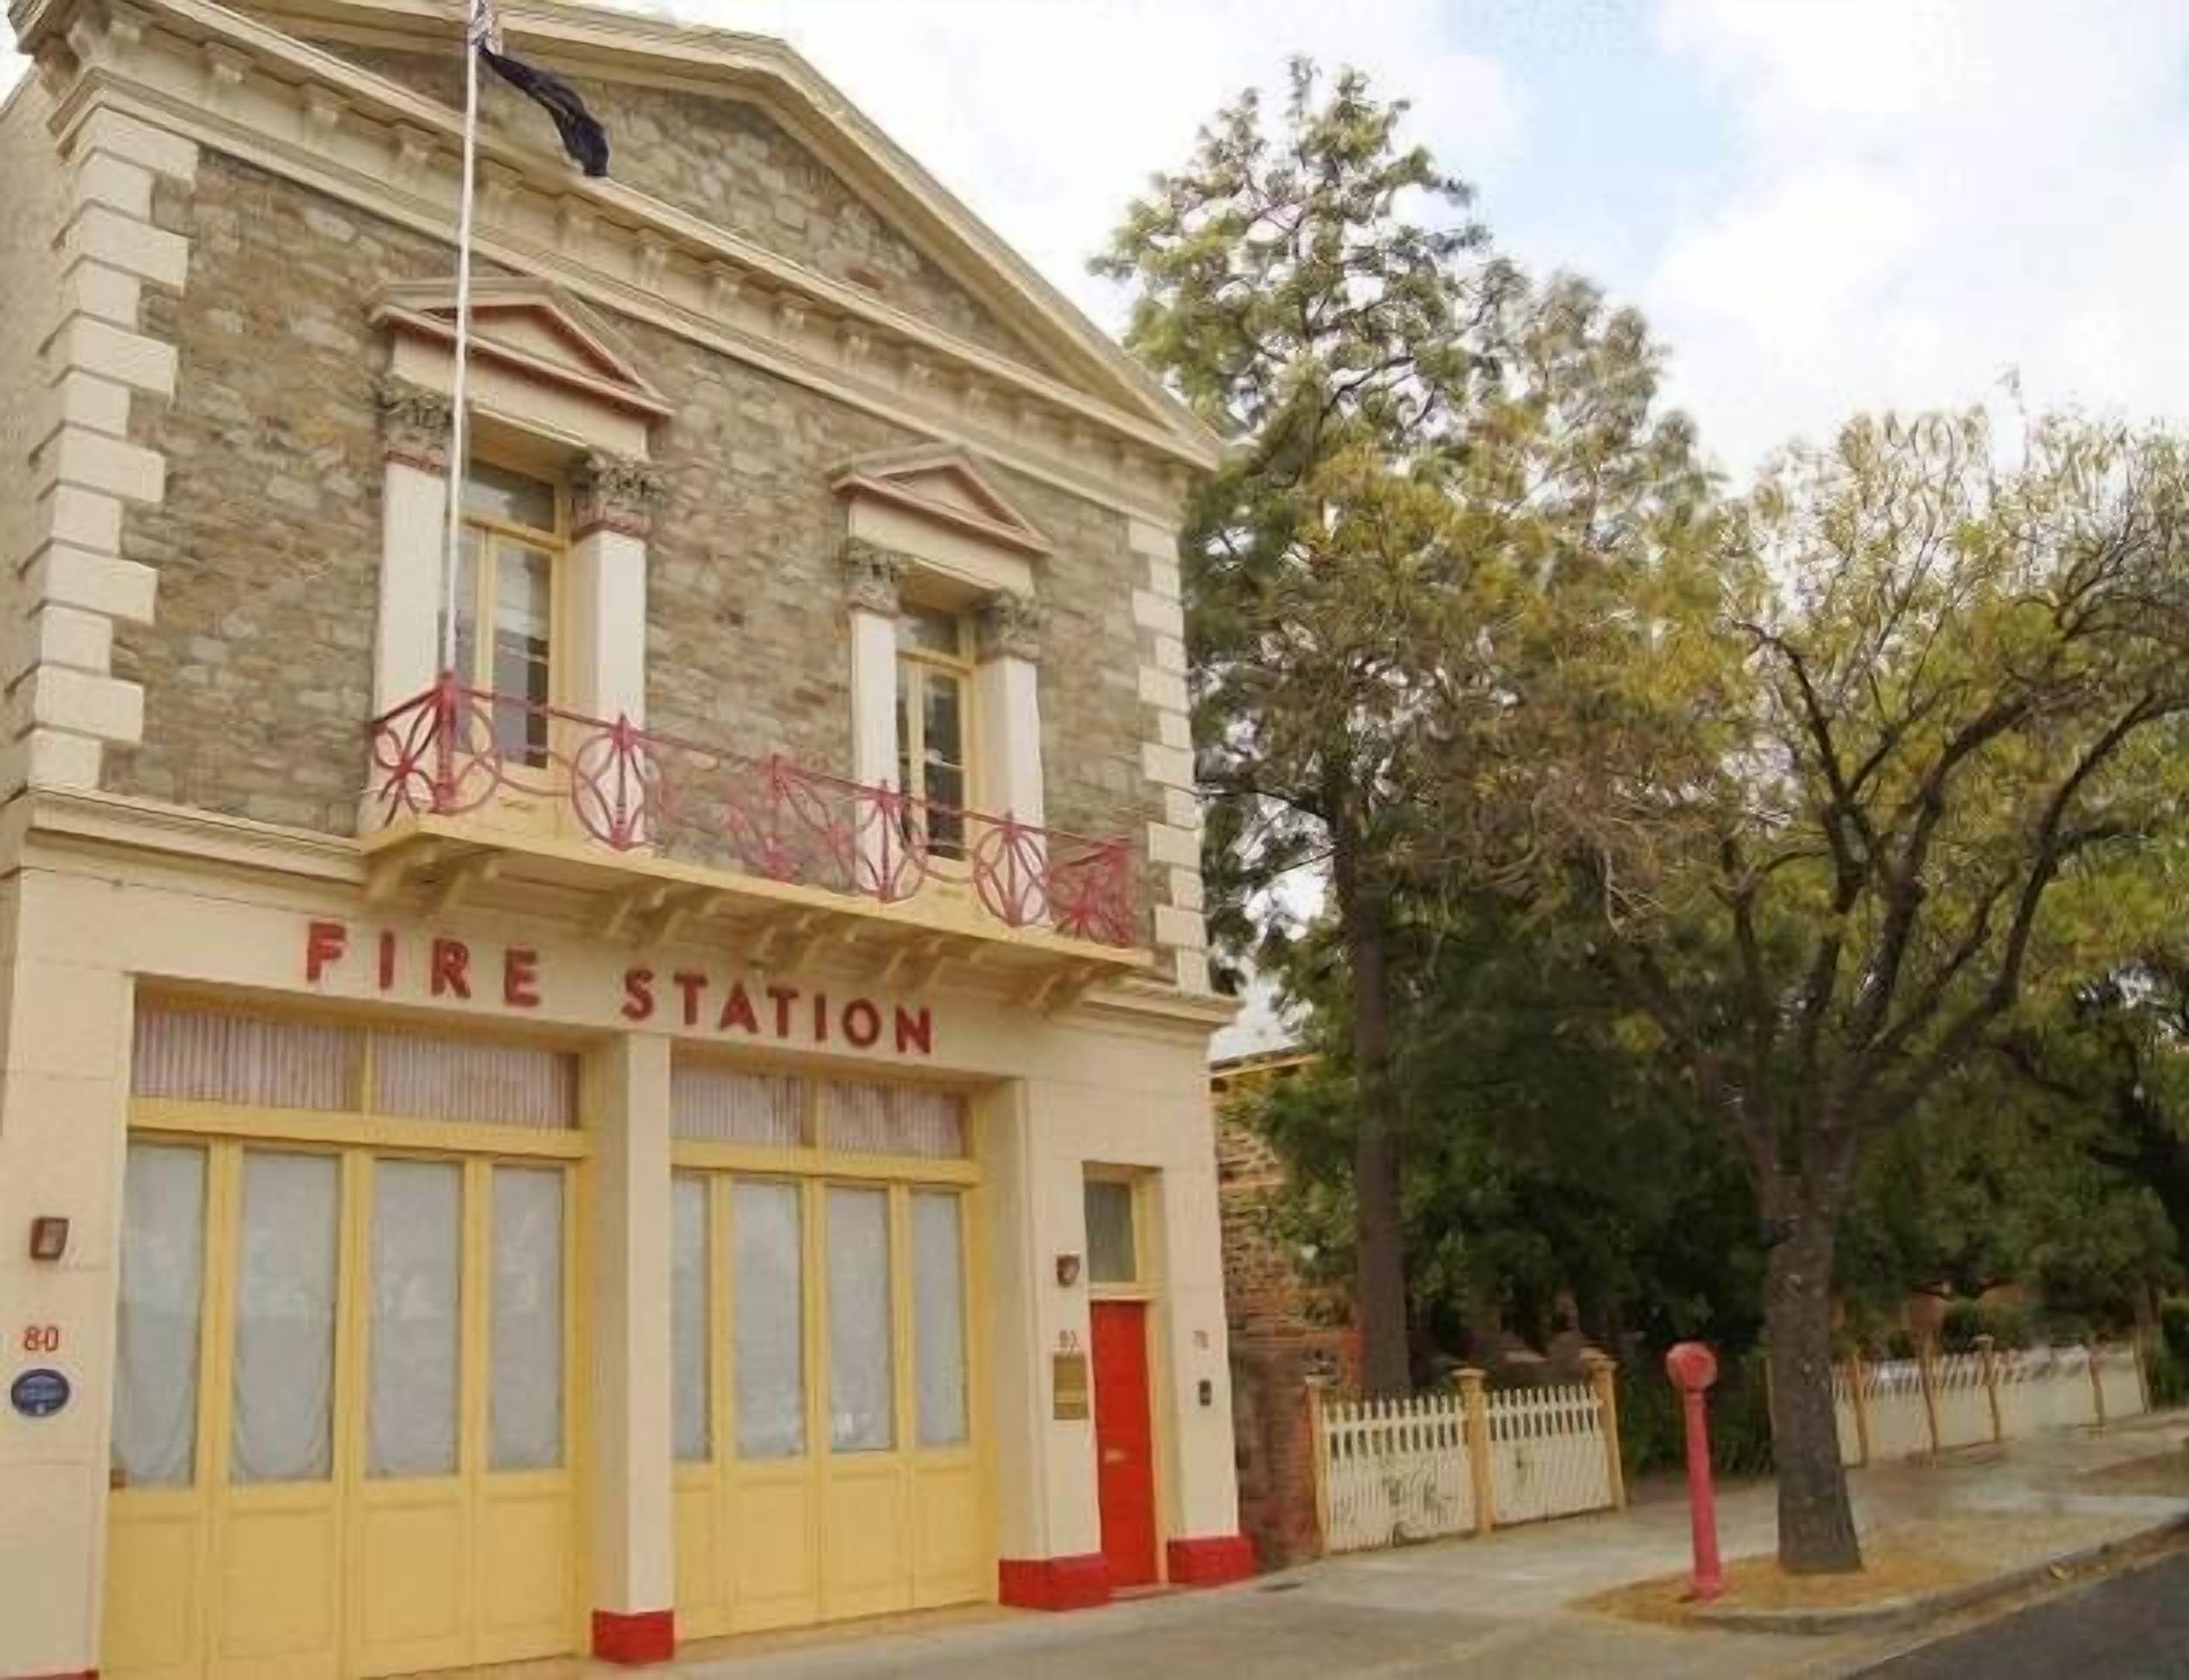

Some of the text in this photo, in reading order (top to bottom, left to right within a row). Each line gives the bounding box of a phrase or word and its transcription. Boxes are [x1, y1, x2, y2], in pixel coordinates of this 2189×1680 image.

[306, 921, 933, 1055] FIRE STATION
[23, 1326, 59, 1352] 80
